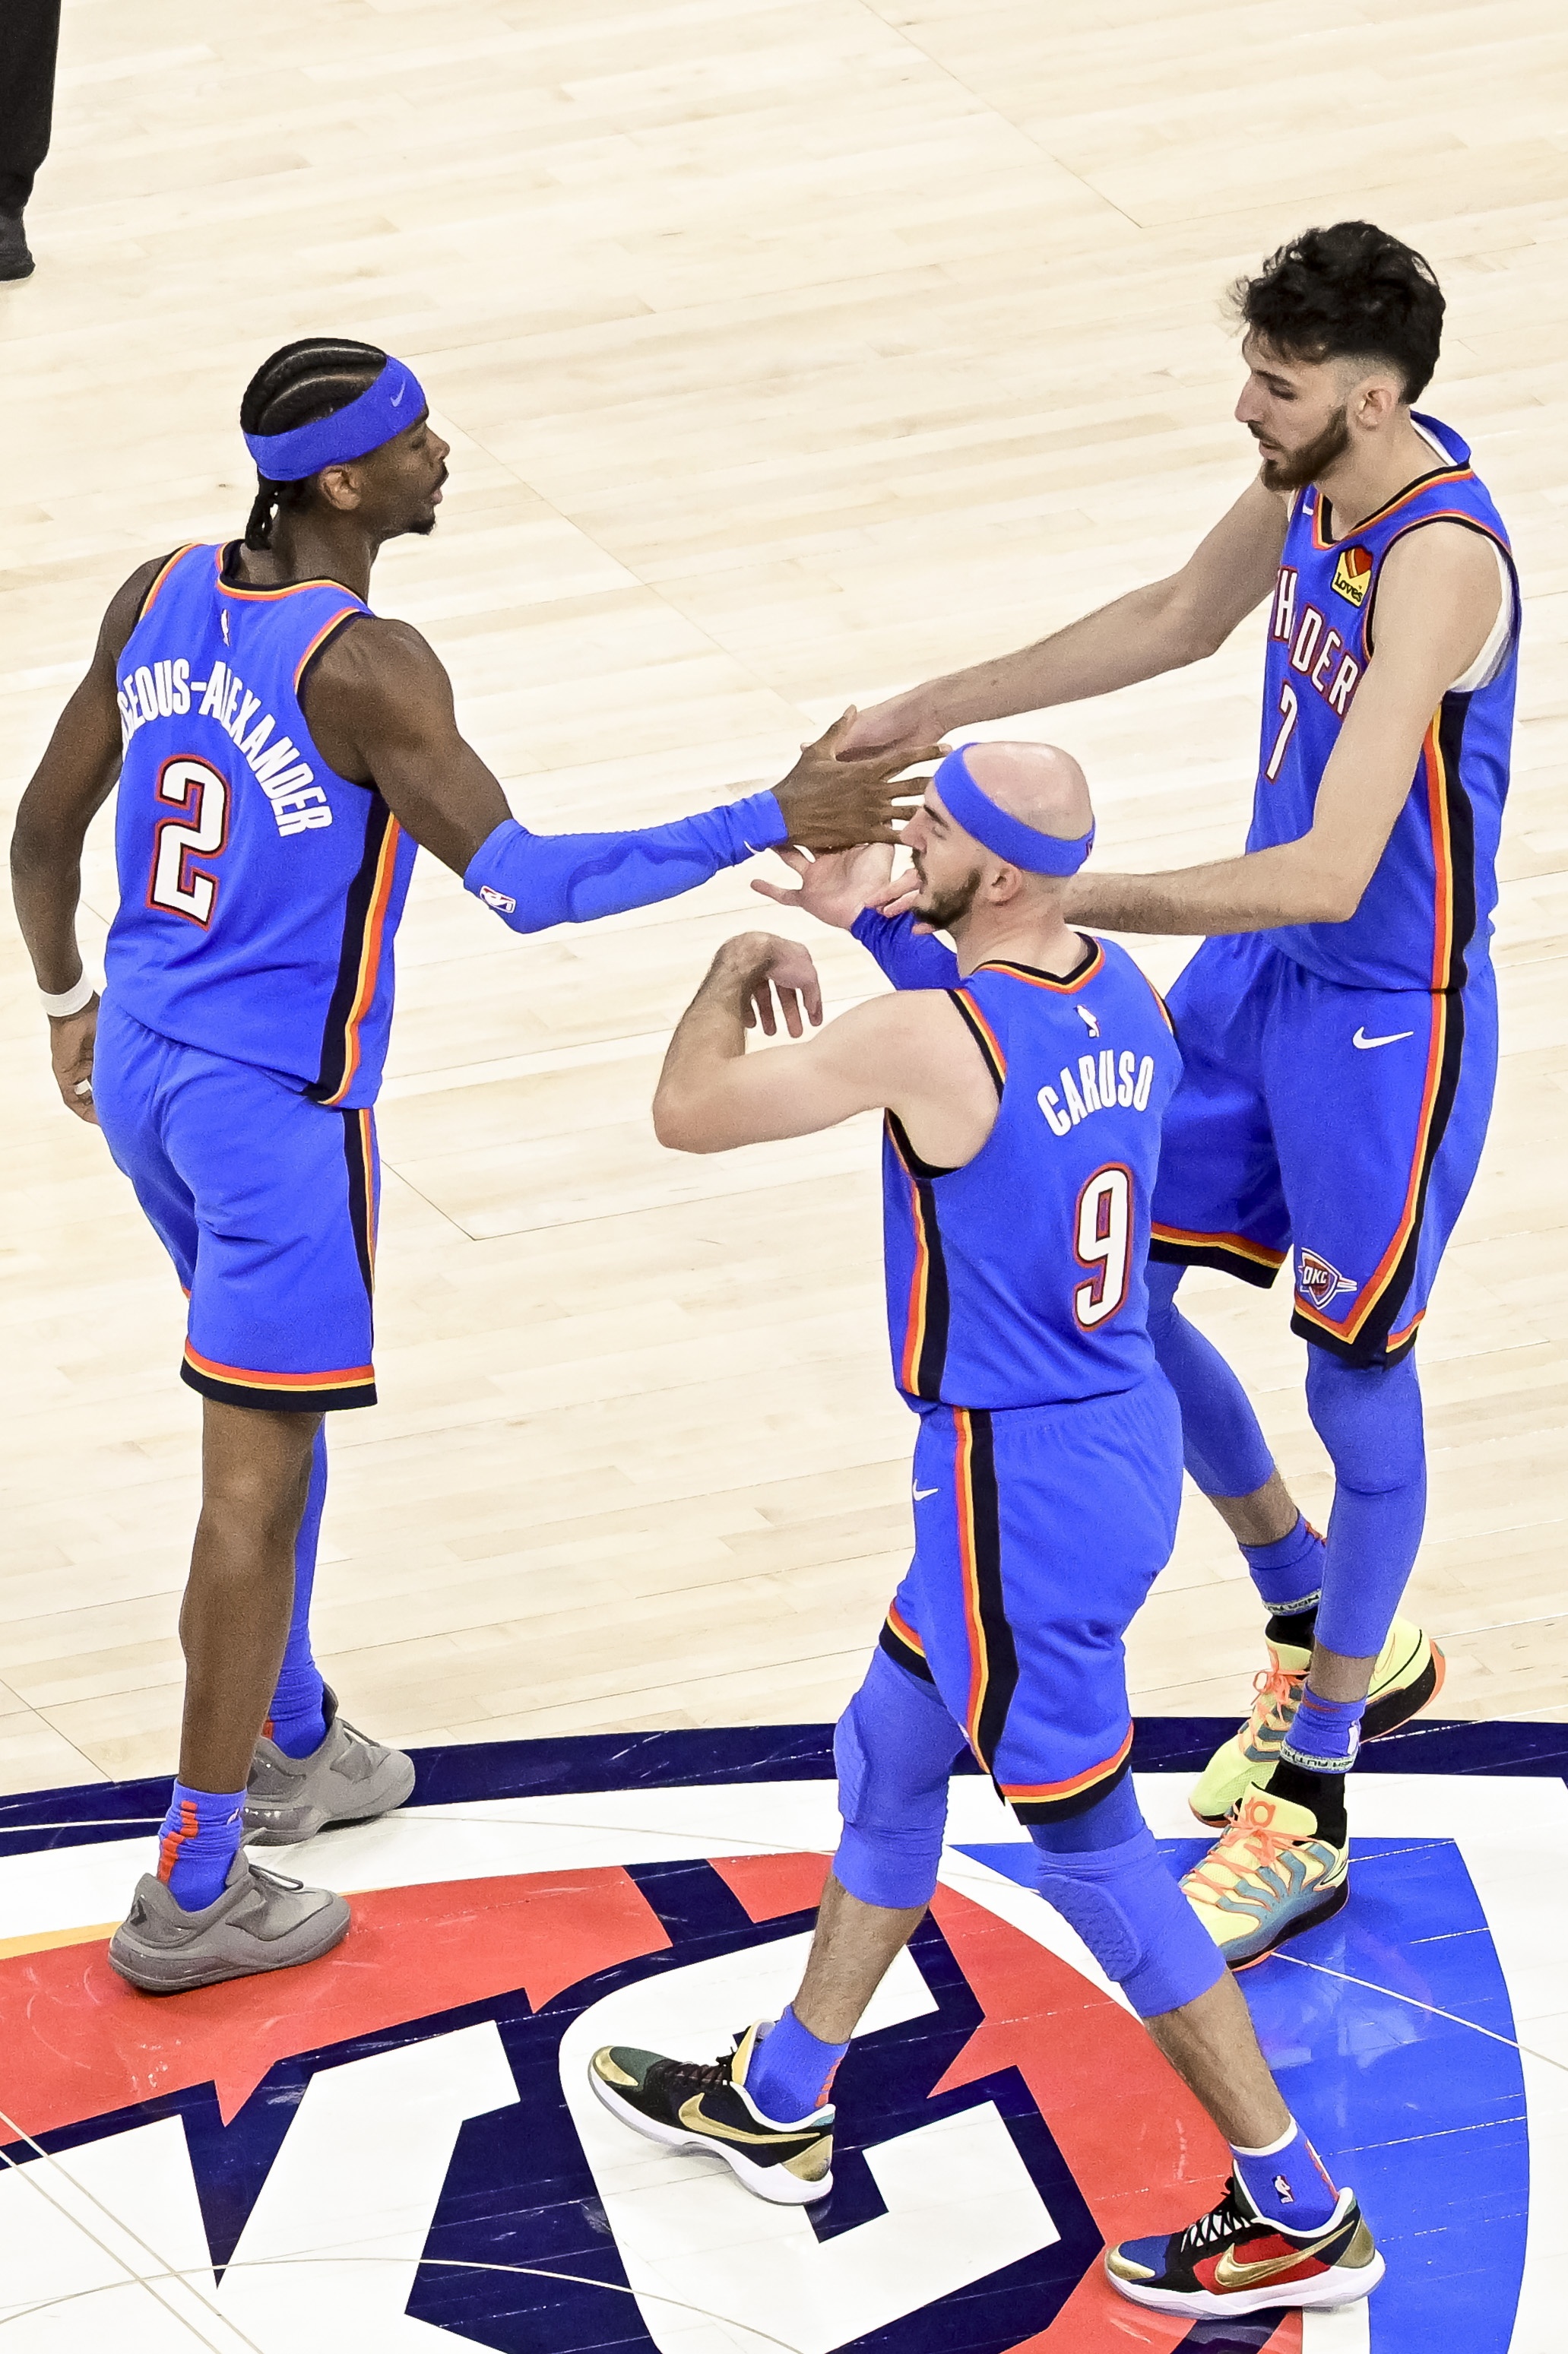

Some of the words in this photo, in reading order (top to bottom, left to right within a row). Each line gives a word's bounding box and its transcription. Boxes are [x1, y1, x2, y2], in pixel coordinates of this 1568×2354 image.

[1334, 572, 1363, 602] Love's
[1272, 566, 1361, 718] HDER
[1265, 680, 1298, 784] 7
[146, 752, 231, 932] 2
[1037, 1049, 1155, 1136] CARUSO
[1072, 1161, 1135, 1331] 9
[1302, 1265, 1328, 1285] OKC
